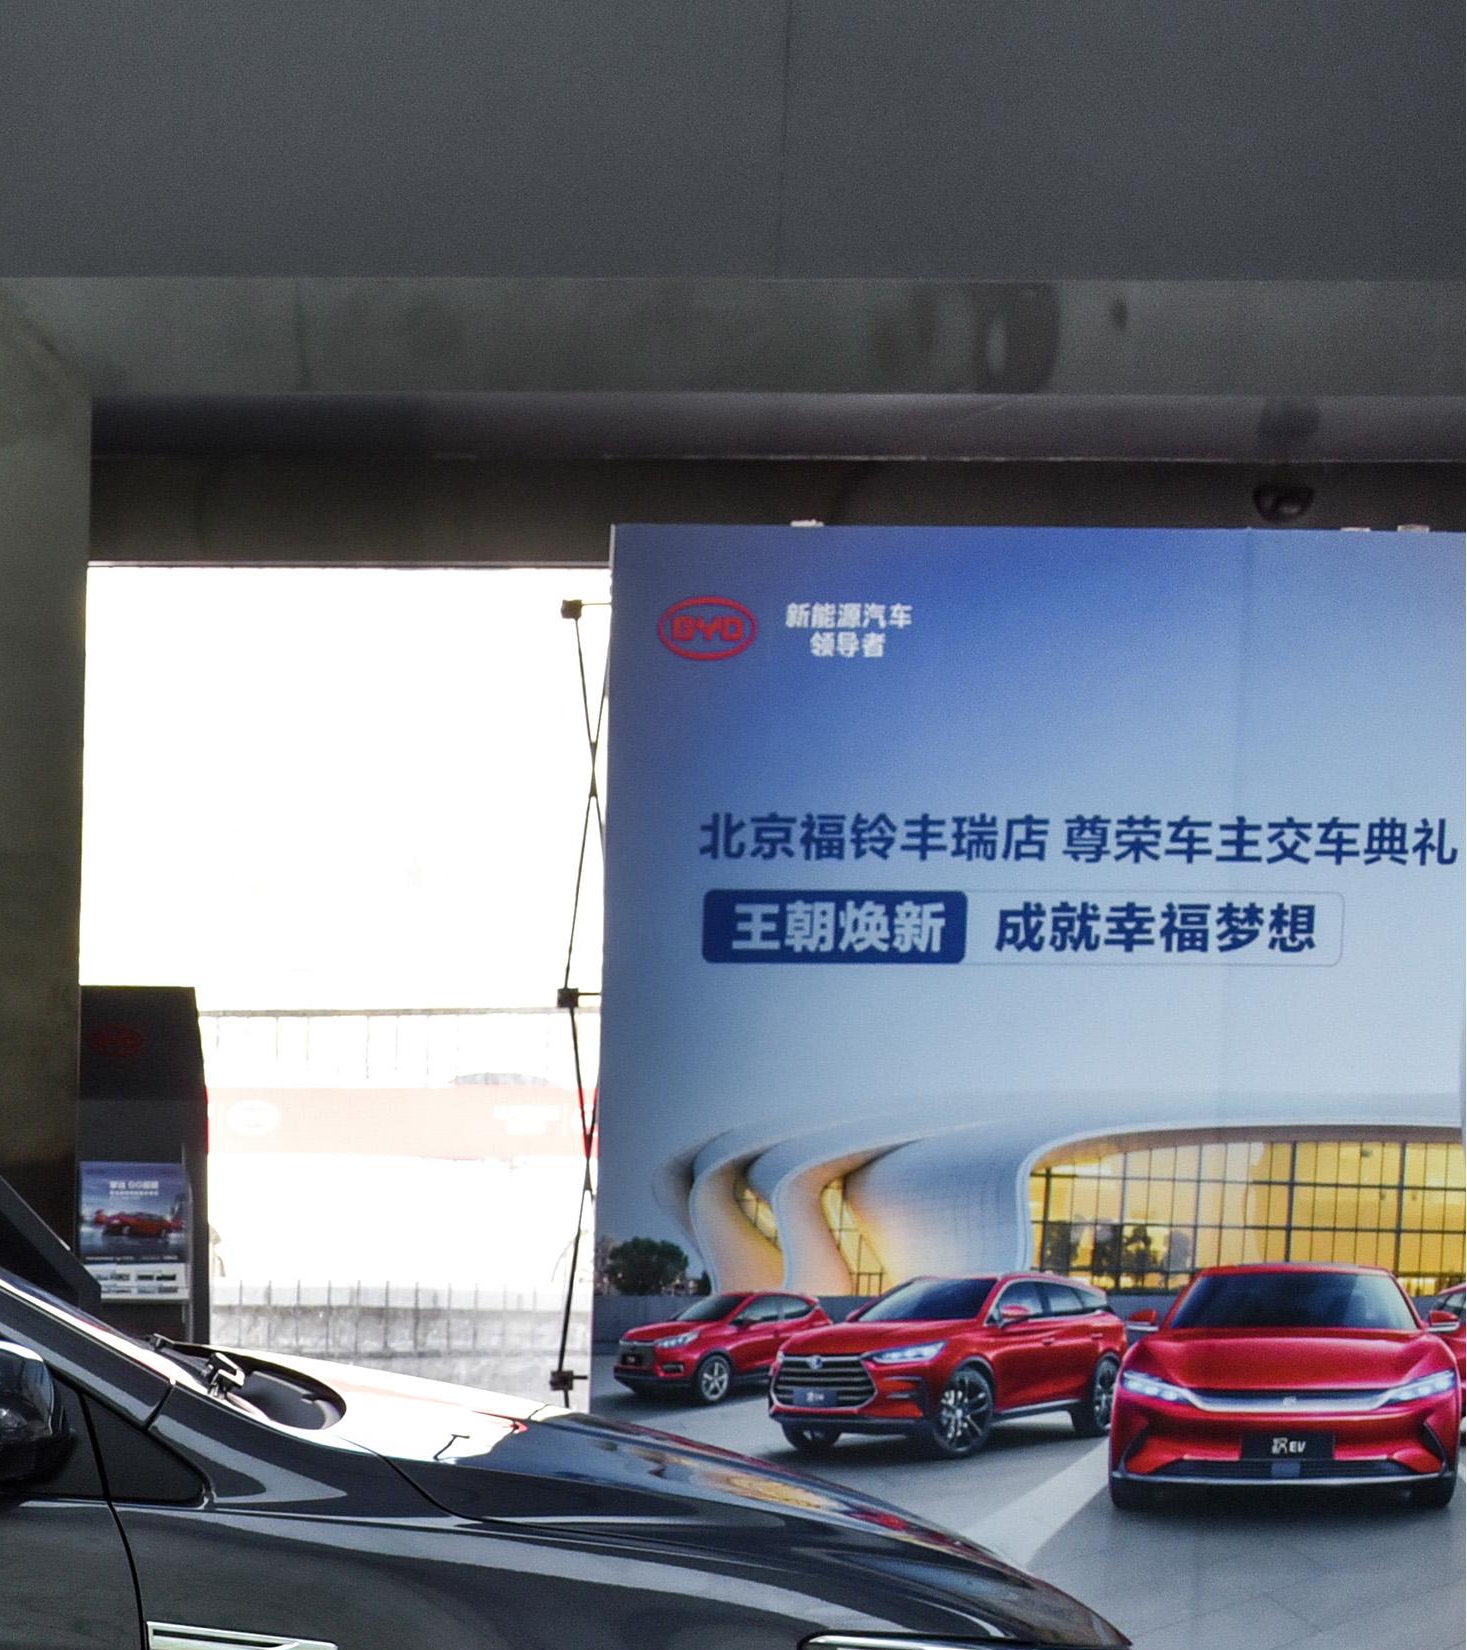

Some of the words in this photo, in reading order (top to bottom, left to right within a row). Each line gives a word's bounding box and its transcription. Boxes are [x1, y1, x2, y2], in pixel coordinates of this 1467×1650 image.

[670, 615, 744, 642] BYD
[784, 602, 914, 629] 新能源汽车
[809, 631, 886, 659] 领导者
[699, 812, 1051, 862] 北京福铃丰瑞店
[1062, 814, 1459, 866] 尊荣车主交车典礼
[731, 900, 946, 954] 王朝焕新
[994, 901, 1317, 953] 成就幸福梦想
